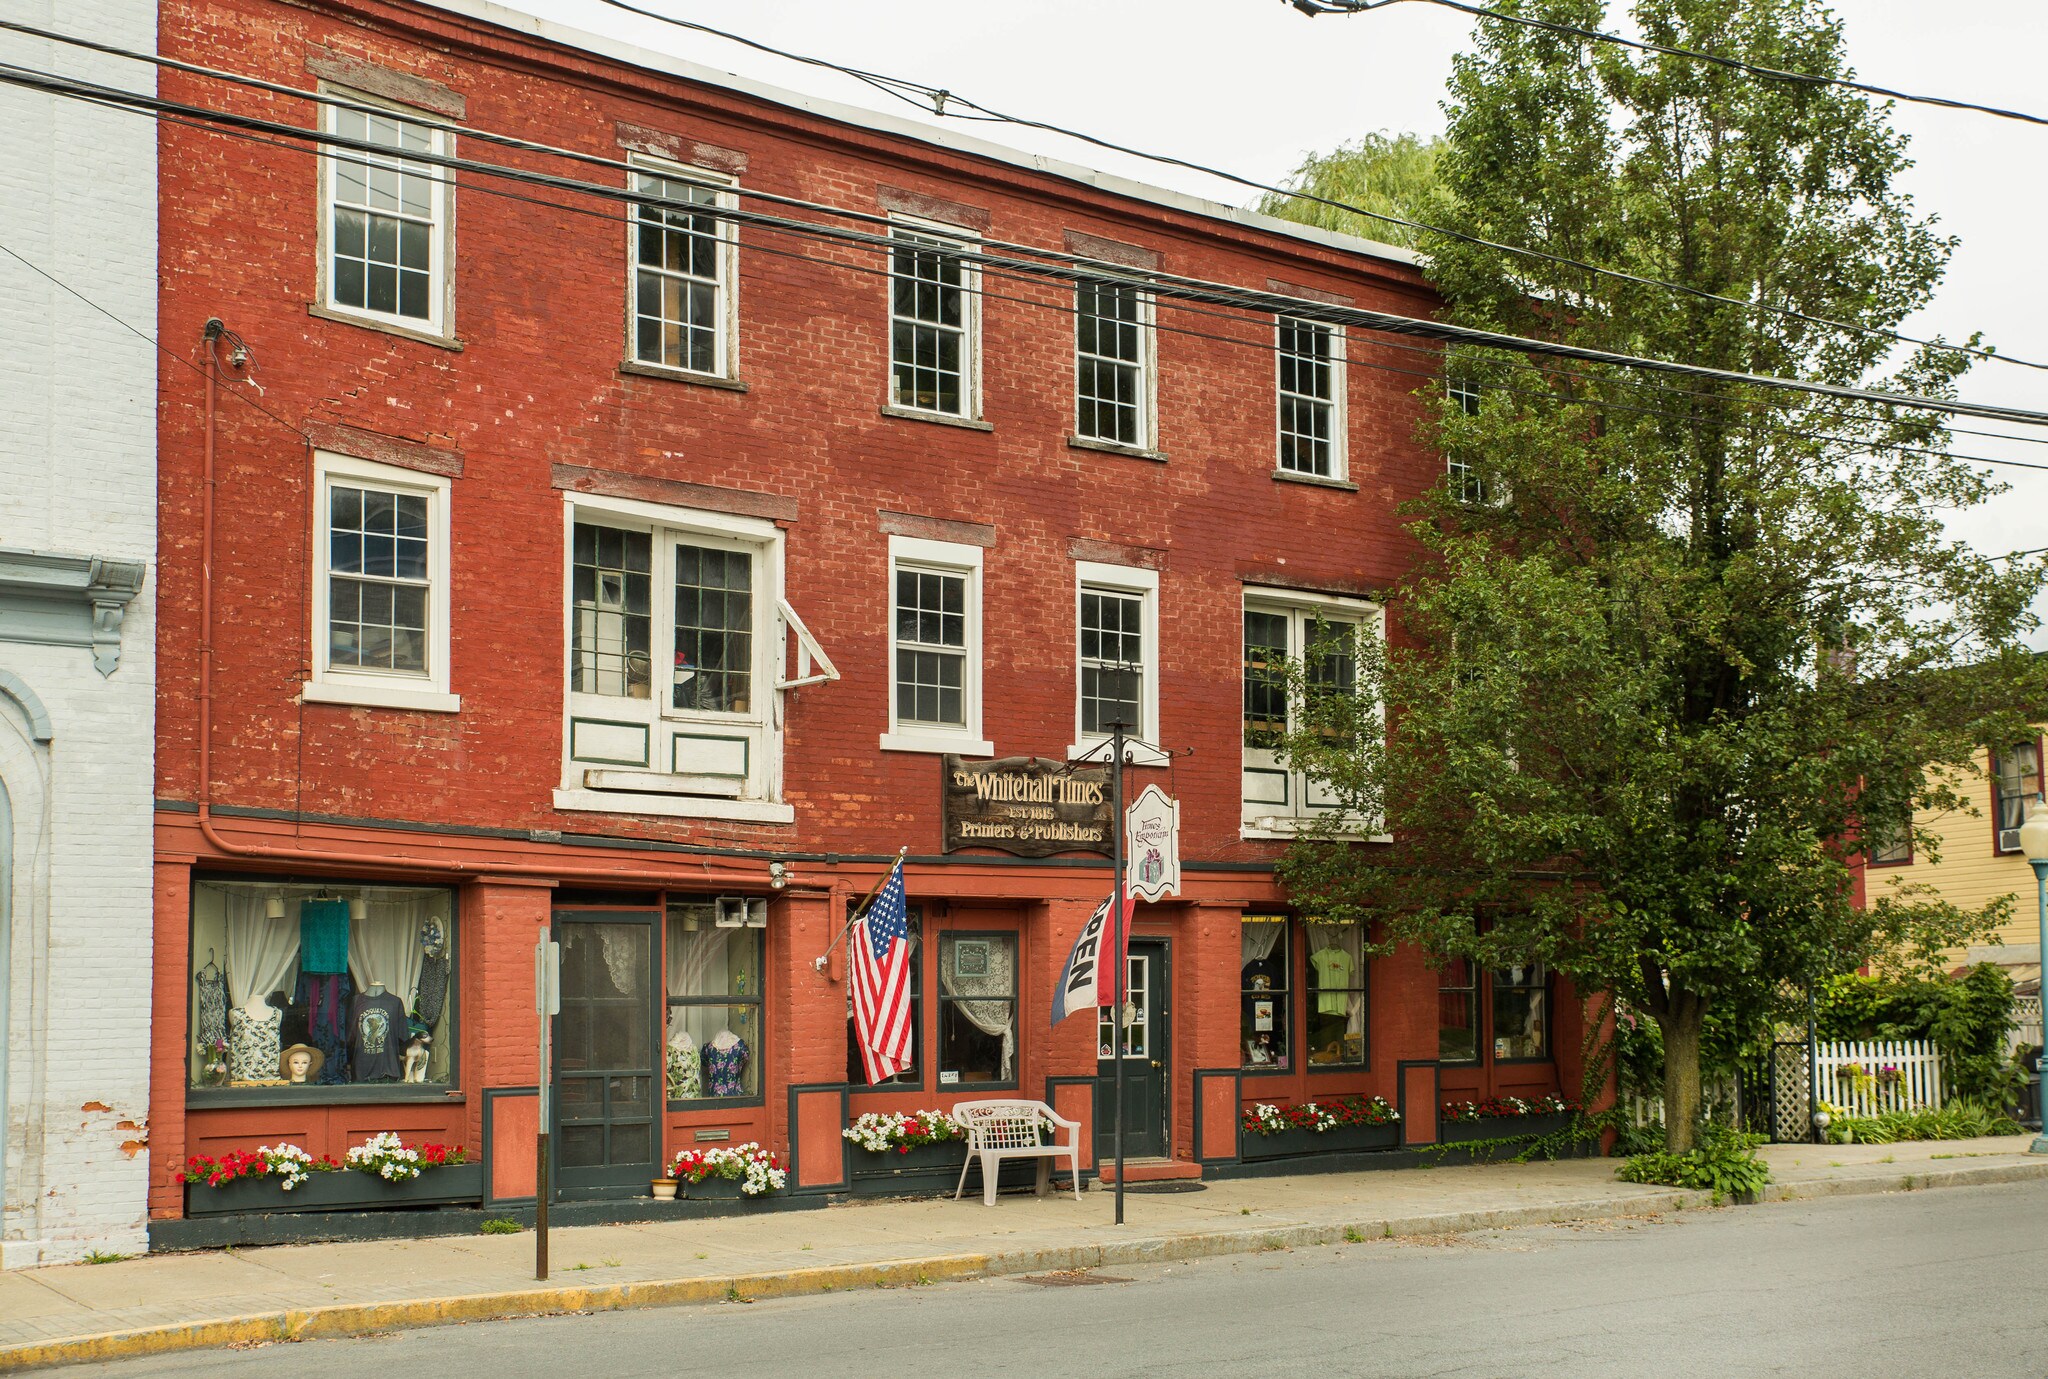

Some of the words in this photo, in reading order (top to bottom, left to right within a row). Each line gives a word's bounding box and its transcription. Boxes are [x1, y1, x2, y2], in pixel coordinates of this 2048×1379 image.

[954, 771, 976, 787] The
[974, 772, 1052, 802] Whitehall
[1053, 776, 1103, 804] Times
[1030, 807, 1054, 819] 1815
[961, 821, 1014, 838] Printers
[1020, 821, 1034, 840] &
[1034, 823, 1103, 841] Publishers
[1141, 816, 1162, 831] Times
[1135, 830, 1169, 845] Emporium
[1068, 895, 1113, 994] OPEN
